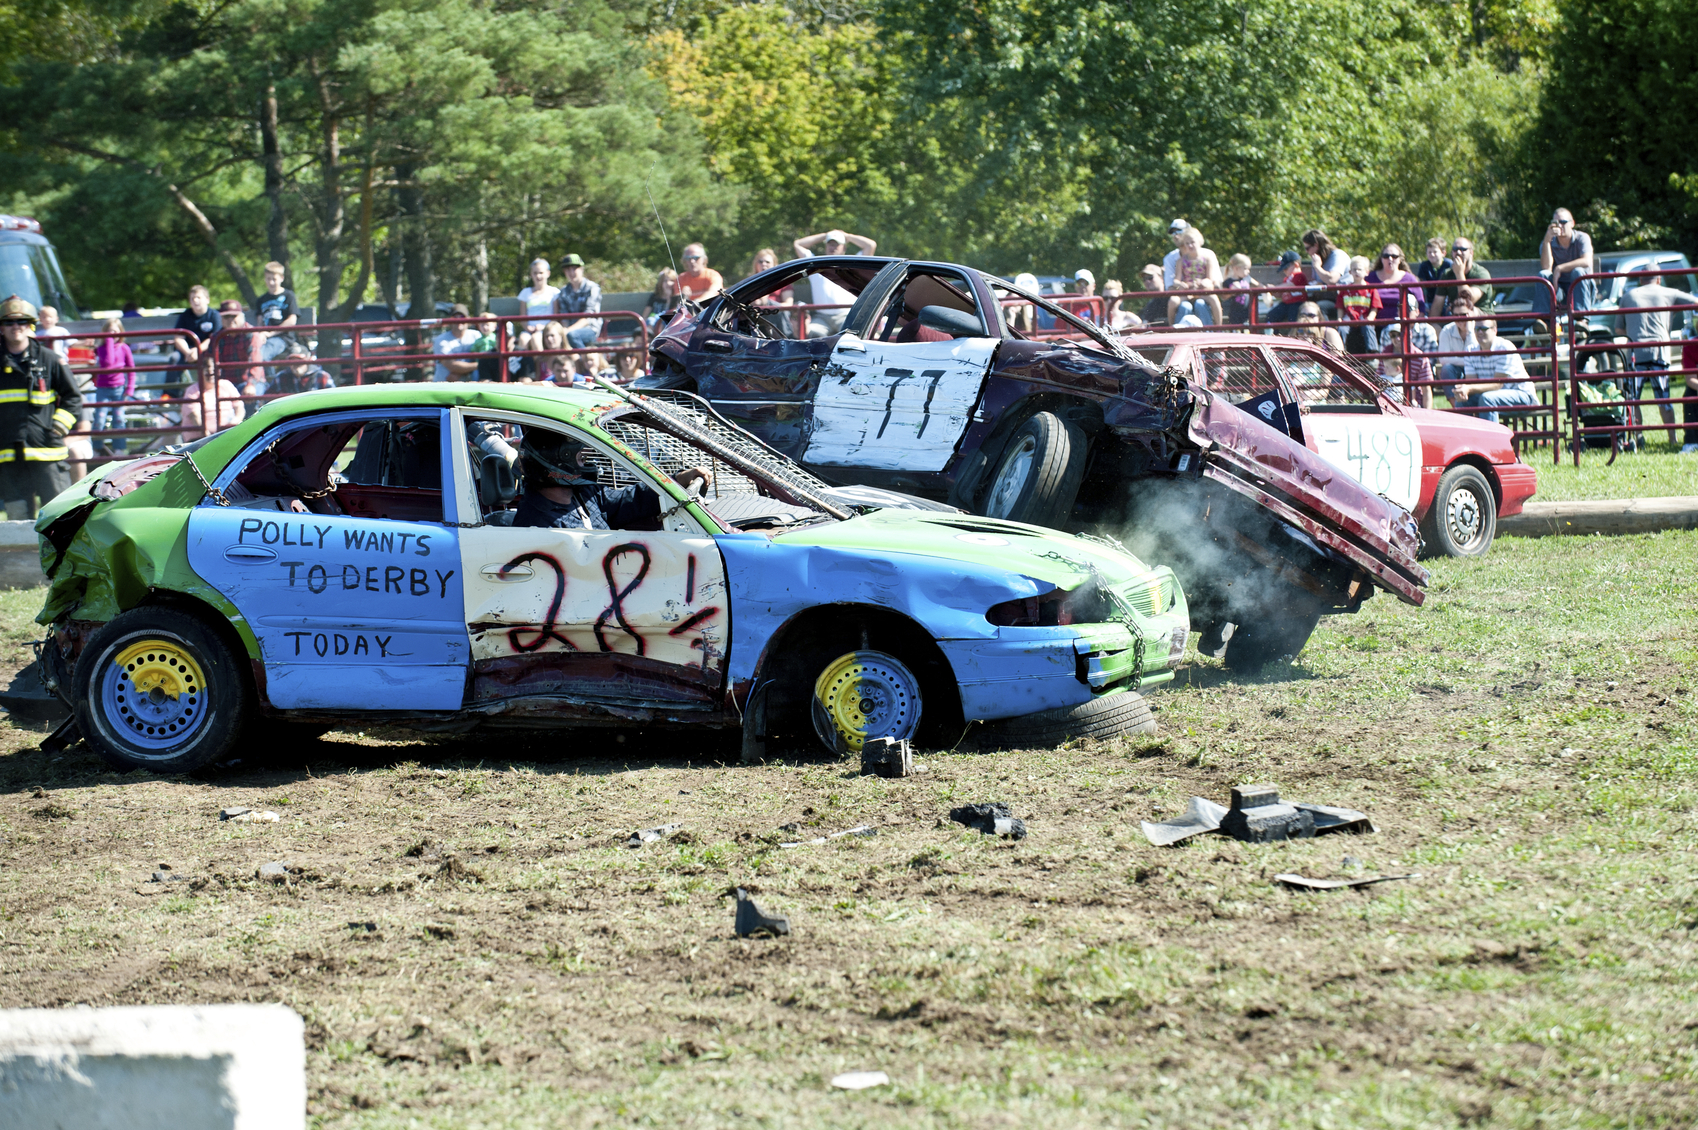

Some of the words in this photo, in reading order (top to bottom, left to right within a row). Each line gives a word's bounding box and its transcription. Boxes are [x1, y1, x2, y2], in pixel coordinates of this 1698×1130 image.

[1345, 425, 1413, 499] 489
[238, 518, 333, 549] POLLY
[344, 529, 432, 557] WANTS
[280, 561, 328, 594] TO
[342, 564, 455, 599] DERBY
[283, 631, 393, 658] TODAY
